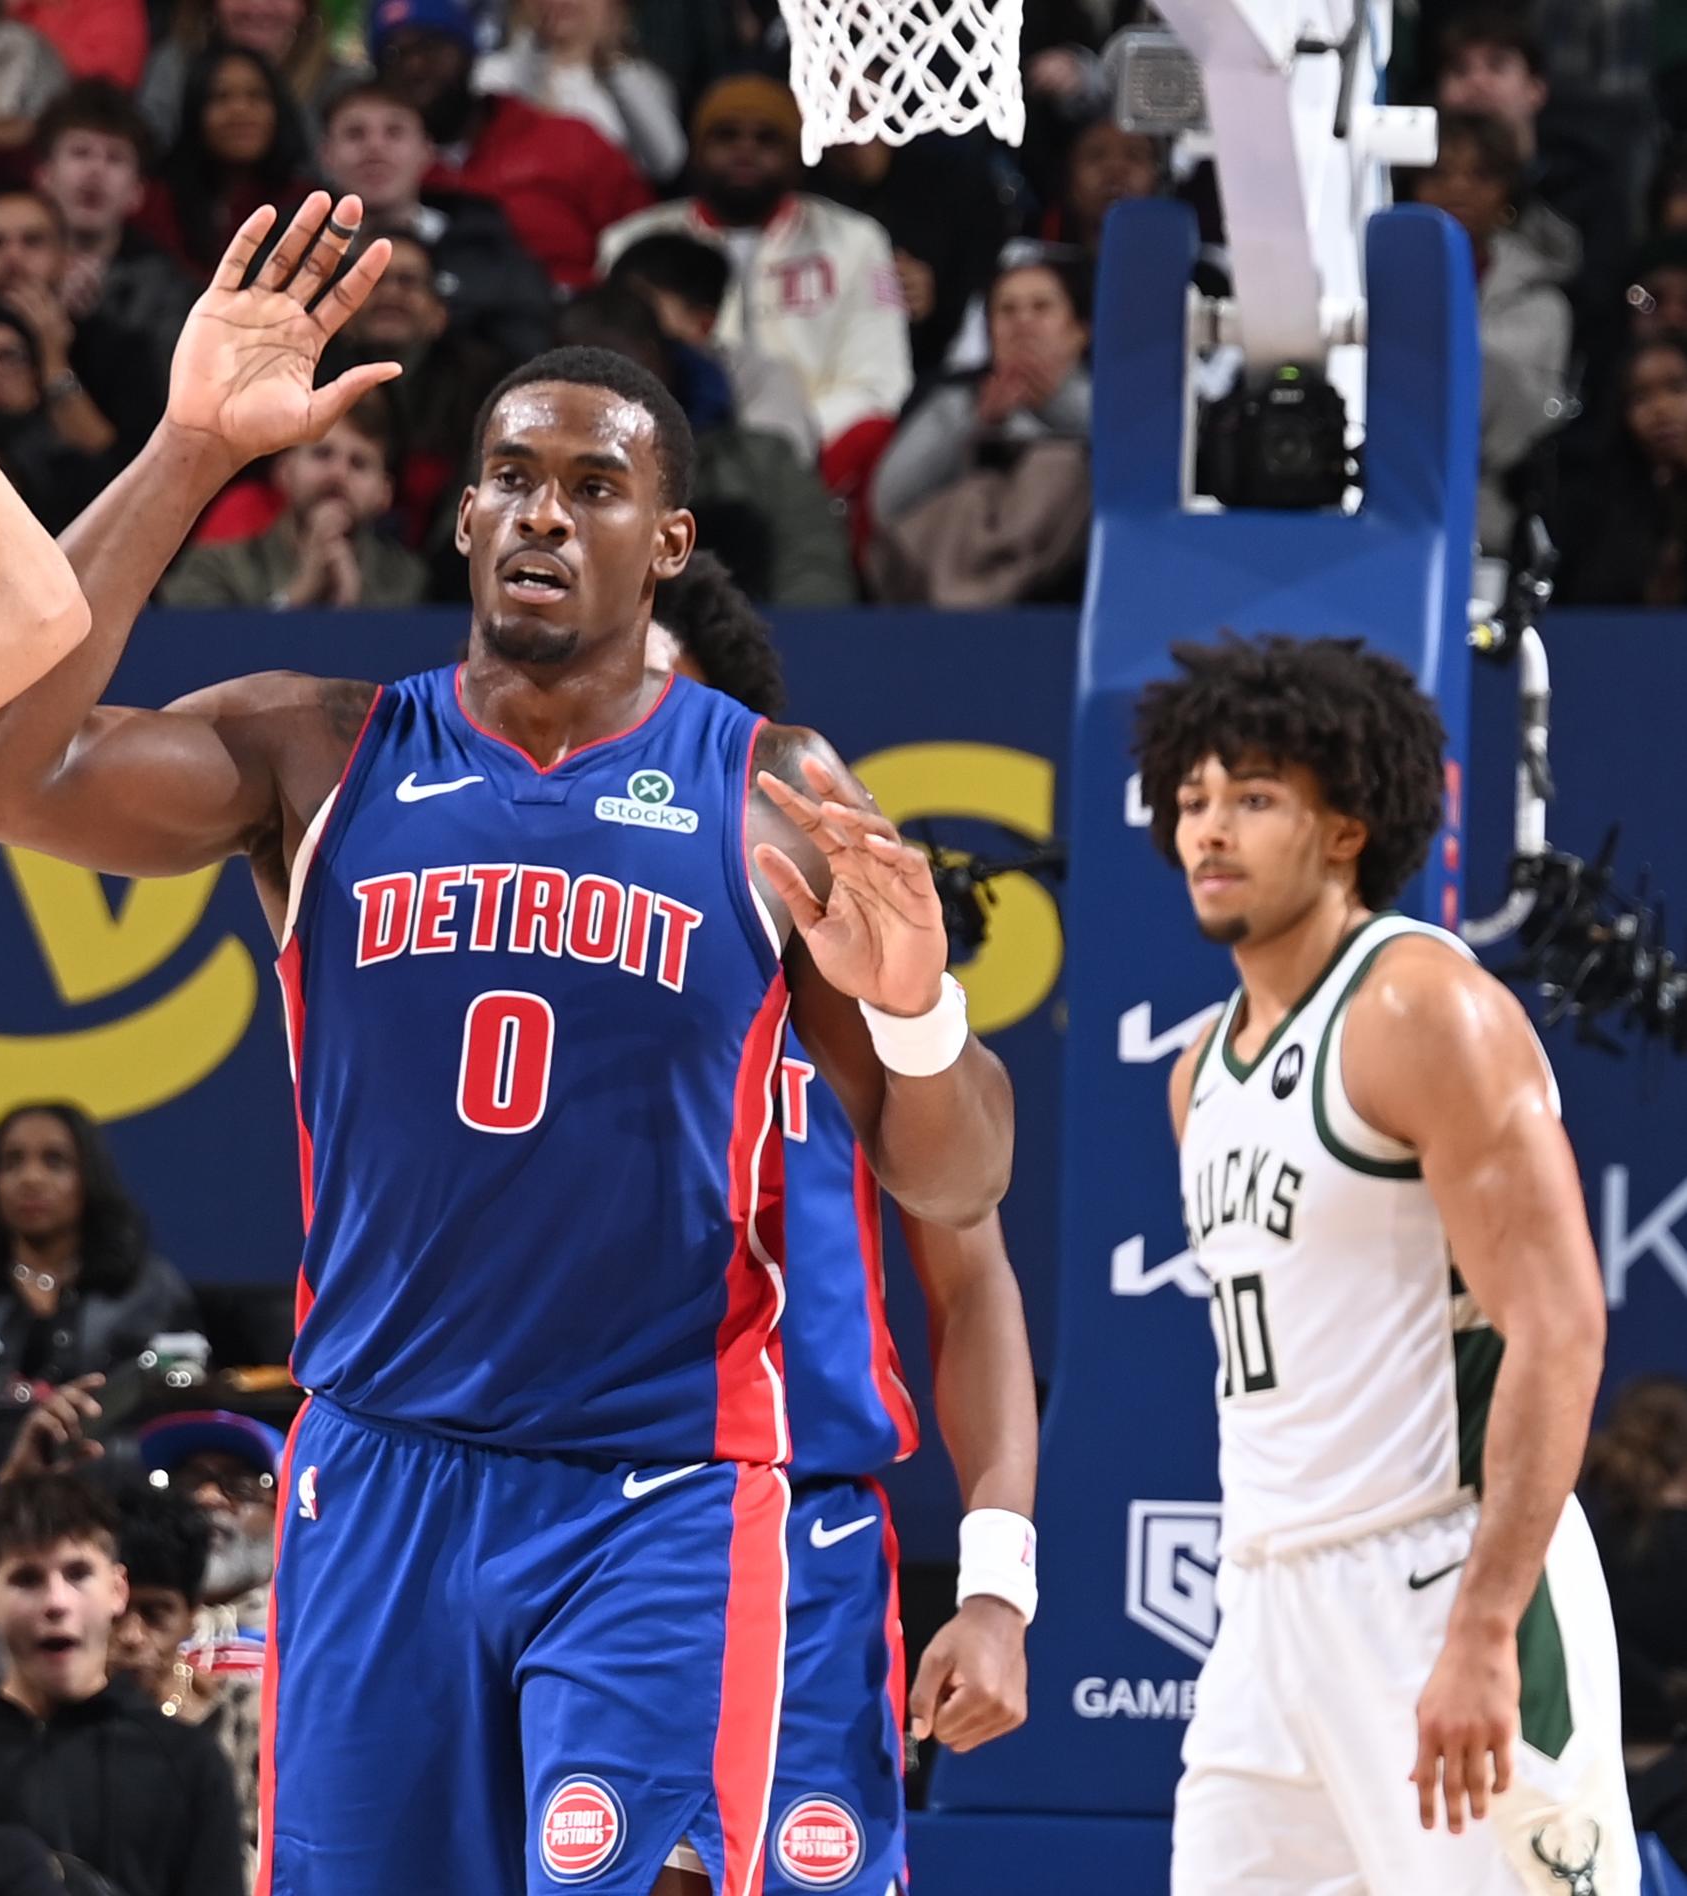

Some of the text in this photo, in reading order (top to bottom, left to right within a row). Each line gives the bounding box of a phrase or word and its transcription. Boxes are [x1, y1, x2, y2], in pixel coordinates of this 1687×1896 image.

[600, 800, 694, 829] StockX
[352, 863, 704, 993] DETROIT
[456, 990, 555, 1135] 0
[1183, 1146, 1303, 1250] UCKS
[550, 1827, 604, 1846] PISTONS
[553, 1811, 605, 1828] DETROIT
